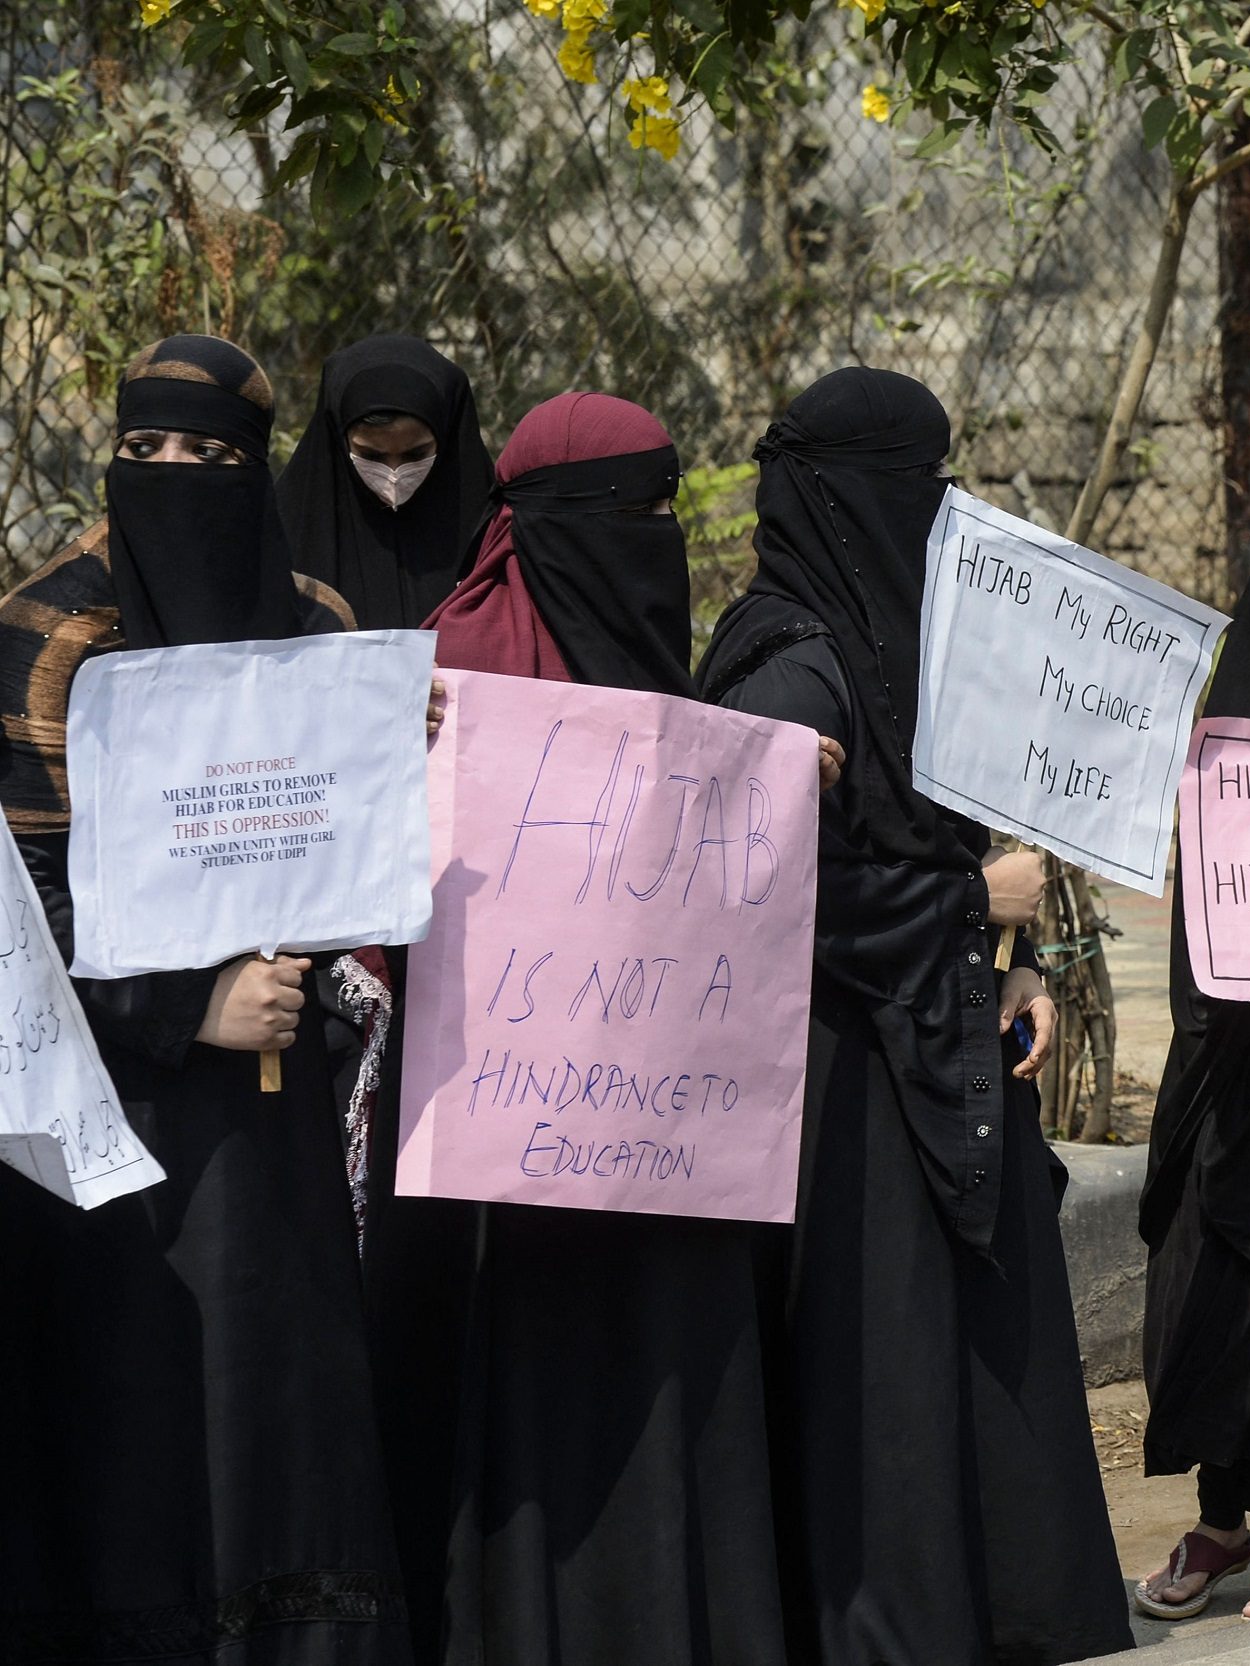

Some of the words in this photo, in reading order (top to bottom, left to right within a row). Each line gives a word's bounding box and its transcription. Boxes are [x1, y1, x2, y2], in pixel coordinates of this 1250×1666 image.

[956, 535, 1032, 605] HIJAB
[1054, 586, 1091, 641] My
[1102, 604, 1181, 663] RIGHT
[1039, 655, 1074, 713] My
[1081, 684, 1152, 732] CHOICE
[162, 785, 216, 802] MUSLIM
[219, 781, 259, 797] GIRLS
[263, 778, 281, 792] TO
[284, 772, 337, 790] REMOVE
[206, 764, 223, 778] DO
[226, 761, 252, 776] NOT
[256, 756, 296, 772] FORCE
[1023, 739, 1059, 794] My
[1064, 759, 1113, 800] LIFE
[173, 821, 209, 840] THIS
[214, 819, 228, 836] IS
[232, 808, 330, 834] OPPRESSION!
[175, 800, 214, 817] HIJAB
[218, 798, 245, 812] FOR
[249, 789, 326, 809] EDUCATION!
[496, 719, 779, 916] HIJAB
[168, 847, 188, 858] WE
[191, 843, 226, 857] STAND
[228, 841, 241, 852] IN
[243, 837, 277, 850] UNITY
[279, 834, 308, 846] WITH
[311, 831, 336, 843] GIRL
[201, 853, 259, 869] STUDENTS
[261, 851, 275, 862] OF
[278, 847, 307, 860] UDIPI
[488, 948, 554, 1023] IS
[569, 957, 679, 1025] NOT
[698, 953, 733, 1024] A
[466, 1048, 689, 1118] HINDRANCE
[700, 1074, 740, 1117] TO
[521, 1121, 696, 1181] EDUCATION
